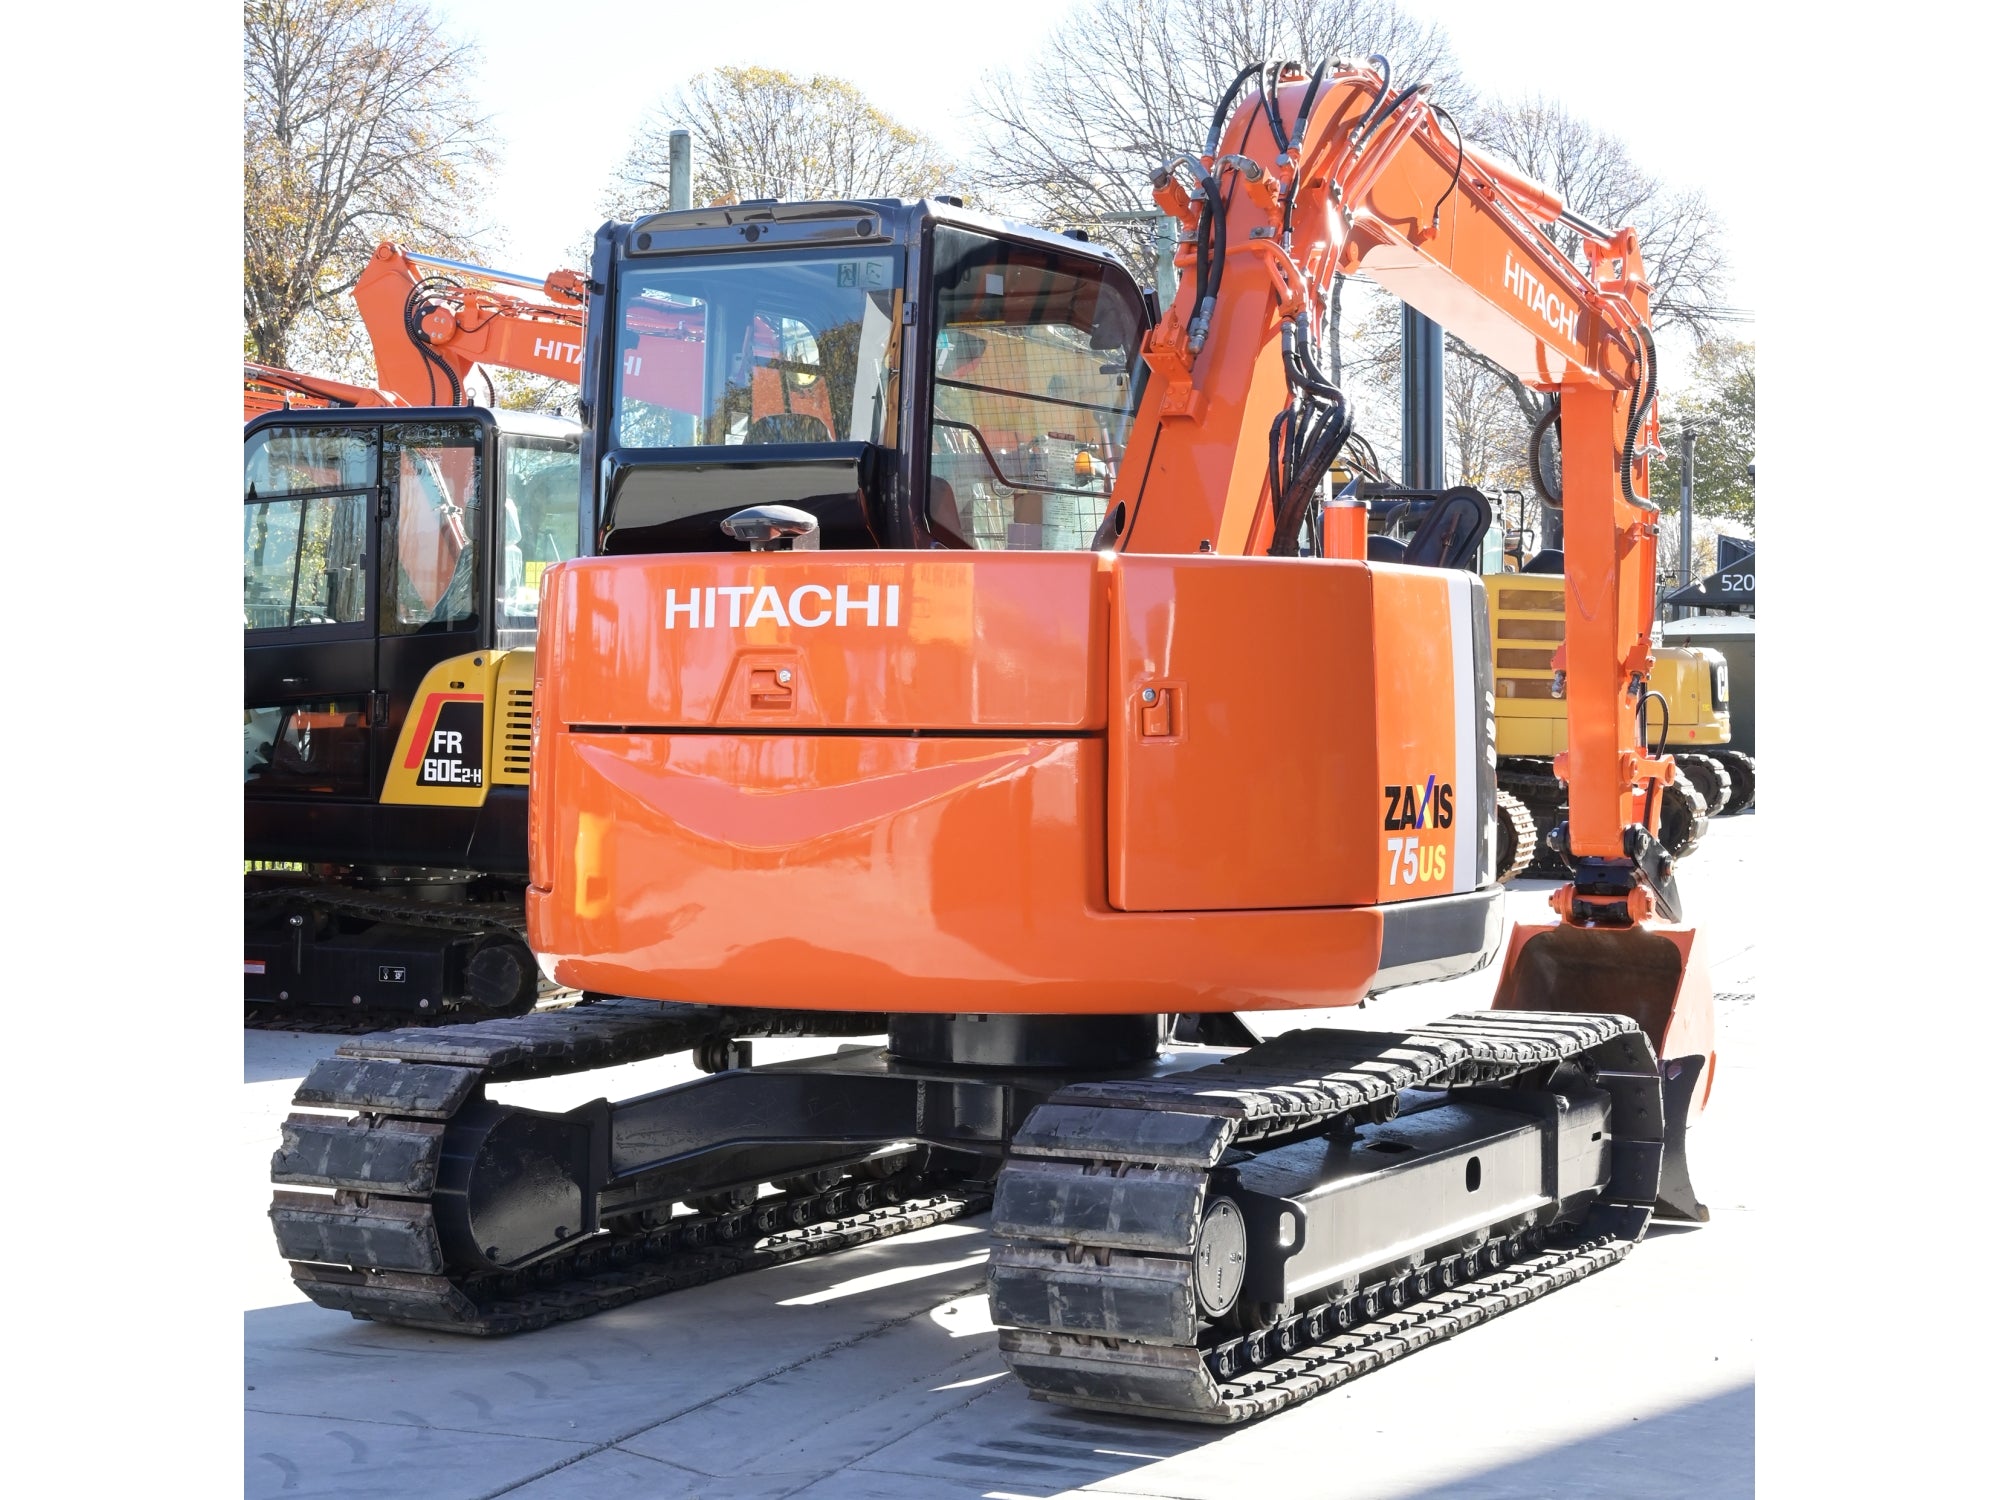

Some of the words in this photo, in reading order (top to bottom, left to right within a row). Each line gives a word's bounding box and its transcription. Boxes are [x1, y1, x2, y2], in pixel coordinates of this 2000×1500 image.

[1503, 254, 1579, 346] HITACHI
[665, 585, 900, 629] HITACHI
[433, 730, 463, 754] FR
[1384, 774, 1453, 831] ZAXIS
[1386, 837, 1447, 886] 75US
